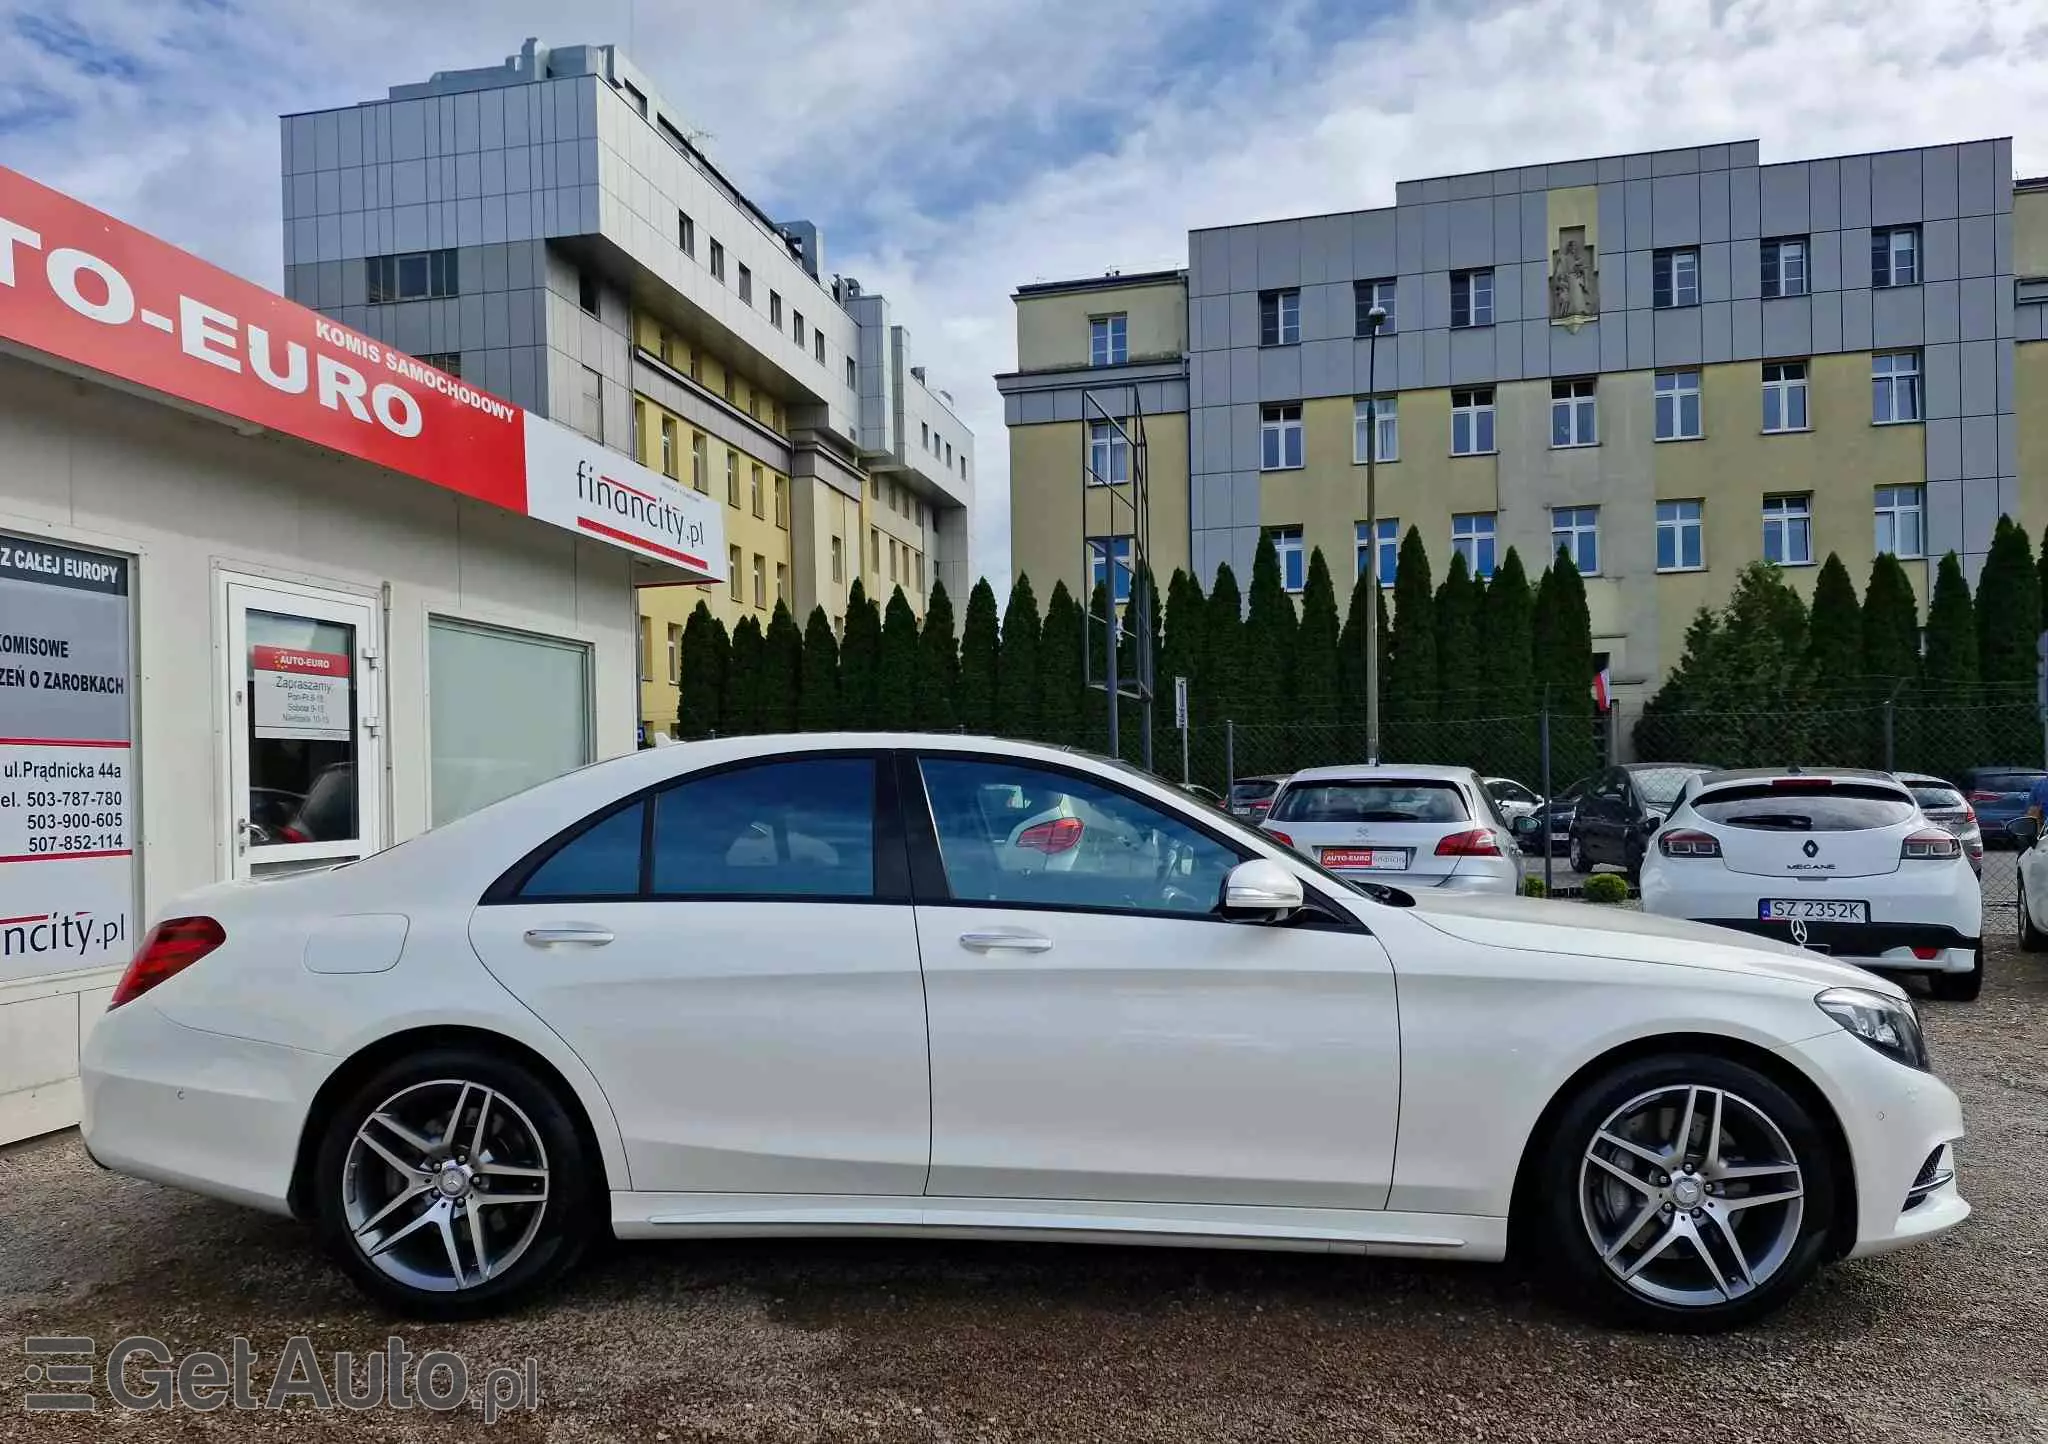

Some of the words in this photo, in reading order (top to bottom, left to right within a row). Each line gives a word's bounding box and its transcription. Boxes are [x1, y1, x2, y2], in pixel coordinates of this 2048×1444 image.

[316, 319, 381, 364] KOMIS
[386, 352, 515, 424] SAMOCHODOWY
[576, 460, 704, 548] financity.pl
[14, 550, 60, 575] CAŁEJ
[64, 558, 118, 584] EUROPY
[0, 634, 69, 658] OMISOWE
[280, 655, 330, 669] AUTO-EURO
[30, 670, 40, 688] O
[43, 672, 124, 694] ZAROBKACH
[4, 761, 95, 783] ul.Prądnicka
[98, 762, 122, 778] 44a
[27, 791, 122, 807] 503-787-780
[27, 812, 123, 830] 503-900-605
[28, 833, 124, 853] 507-852-114
[1774, 901, 1797, 917] SZ
[1804, 902, 1860, 919] 2352K
